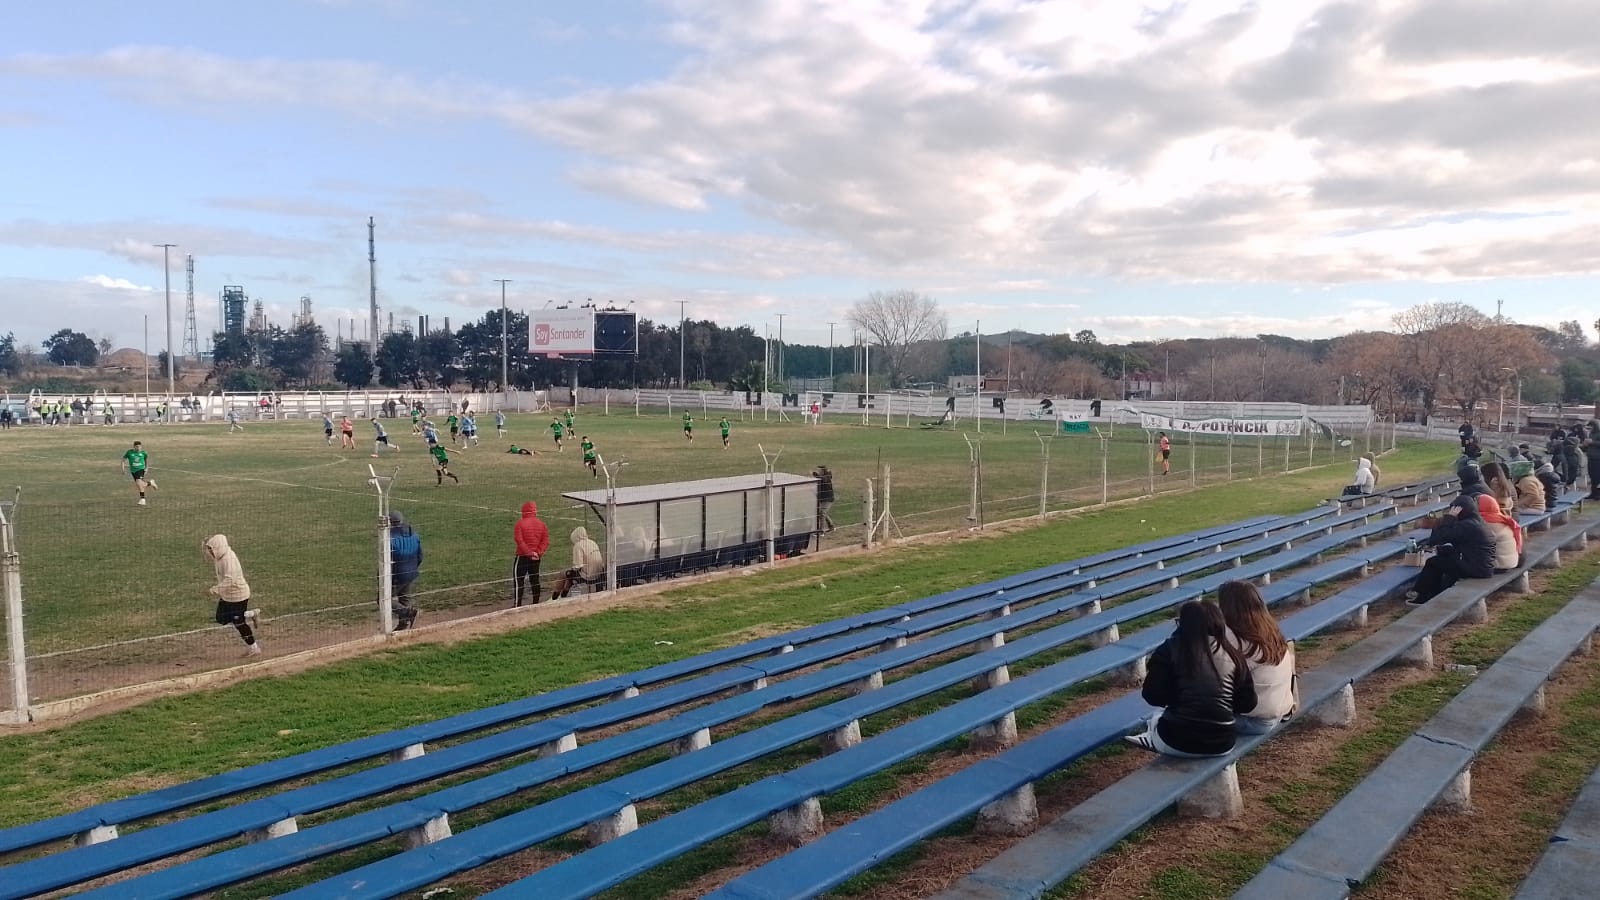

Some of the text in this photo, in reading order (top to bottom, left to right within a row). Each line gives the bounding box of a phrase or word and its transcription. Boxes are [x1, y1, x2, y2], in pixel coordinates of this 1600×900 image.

[536, 328, 586, 343] Soy Santander
[1201, 420, 1268, 434] POTENCIA
